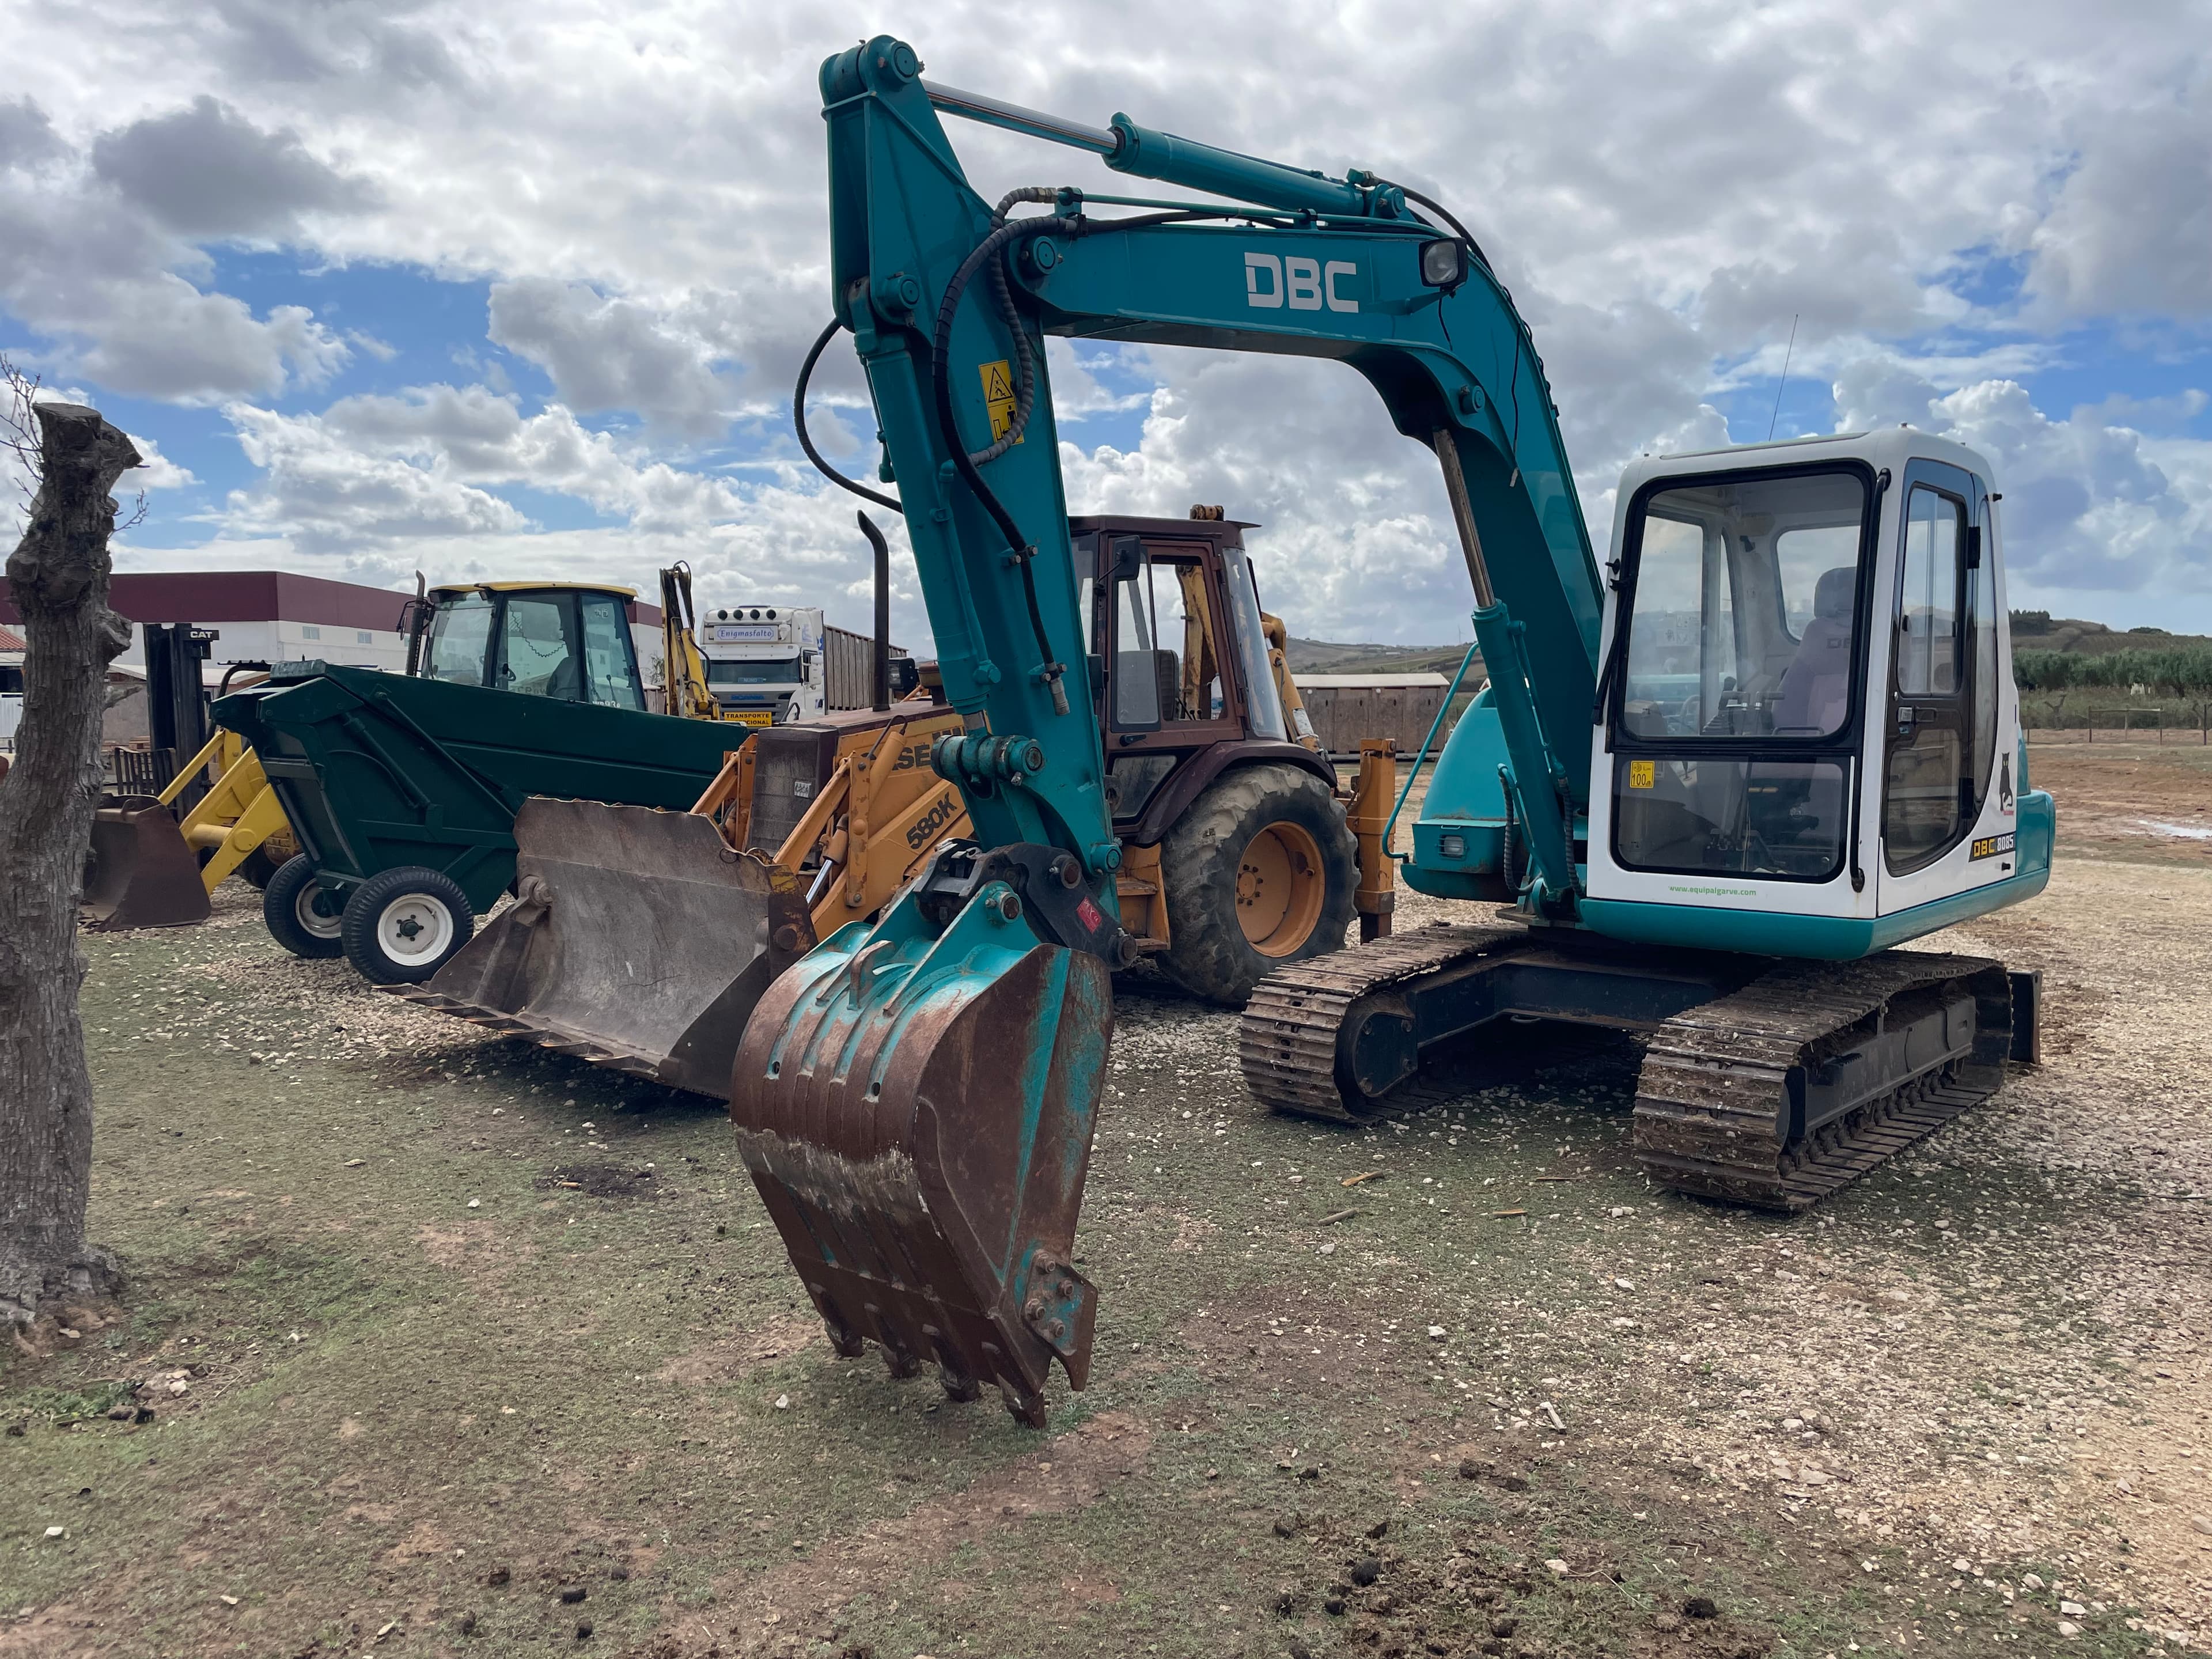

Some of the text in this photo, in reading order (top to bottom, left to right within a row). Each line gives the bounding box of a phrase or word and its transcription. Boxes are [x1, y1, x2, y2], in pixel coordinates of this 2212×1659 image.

[1244, 252, 1359, 313] DBC
[721, 630, 772, 639] Enigmasfalto
[1631, 774, 1646, 786] 100
[906, 791, 957, 850] 580K
[1974, 835, 2014, 857] DBC 8085
[1669, 885, 1756, 896] www.equipalgarve.com
